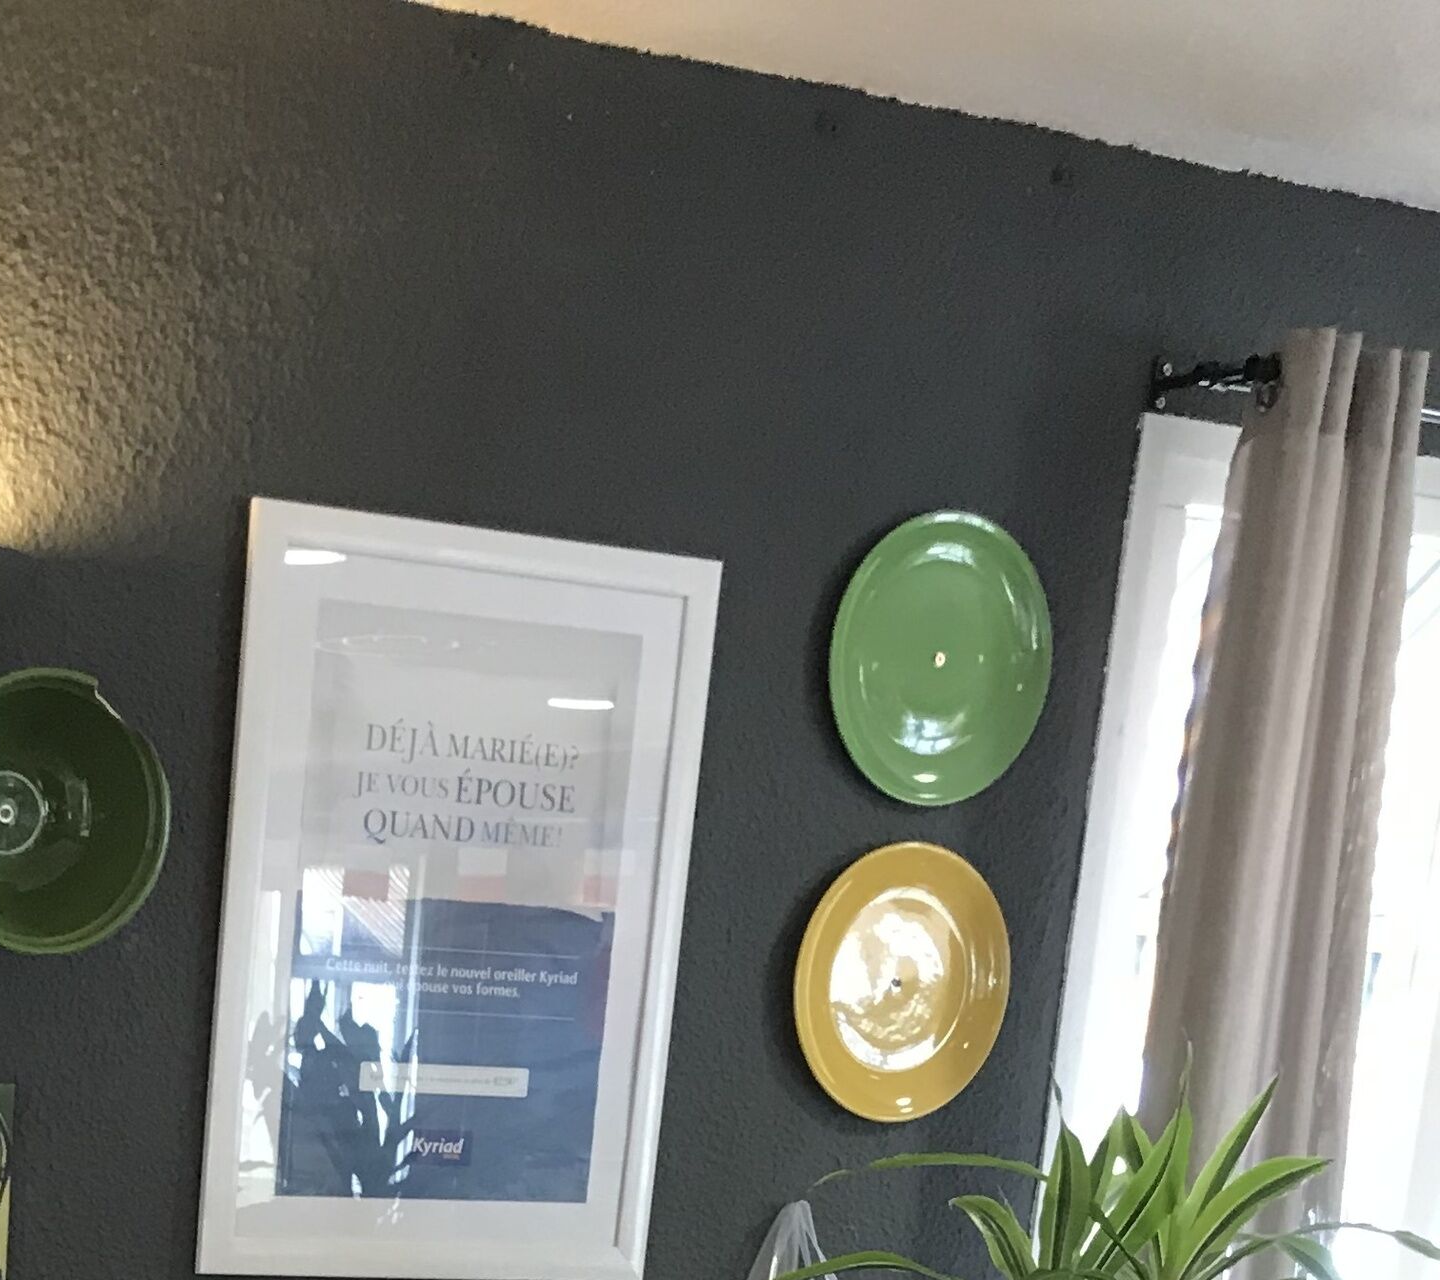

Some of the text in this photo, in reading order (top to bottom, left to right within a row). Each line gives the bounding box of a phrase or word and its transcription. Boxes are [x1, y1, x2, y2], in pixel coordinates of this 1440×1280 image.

[366, 718, 581, 774] DÉJÀ MARIÉ(E)?
[352, 767, 577, 815] JE VOUS ÉPOUSE
[363, 807, 476, 846] QUAND
[437, 963, 449, 978] le
[450, 965, 492, 981] nouvel
[494, 966, 537, 983] oreiller
[538, 969, 579, 987] Kyriad
[451, 982, 473, 997] vos
[413, 1136, 465, 1159] Kyriad
